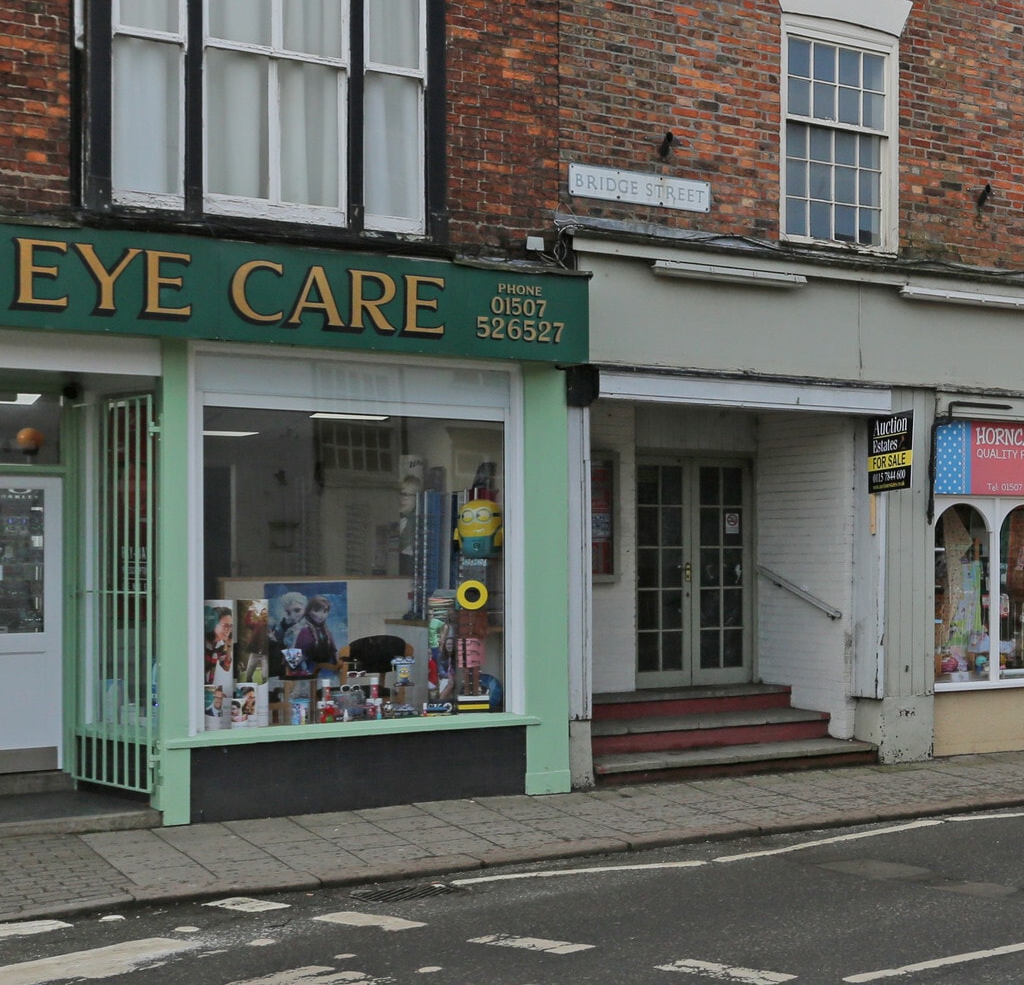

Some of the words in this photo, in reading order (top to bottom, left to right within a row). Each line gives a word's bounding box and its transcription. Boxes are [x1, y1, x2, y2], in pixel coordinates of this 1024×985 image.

[574, 173, 639, 195] BRIDGE
[646, 182, 705, 204] STREET
[12, 236, 193, 318] EYE
[229, 259, 446, 337] CARE
[497, 282, 543, 297] PHONE
[490, 296, 547, 318] 01507
[475, 316, 566, 344] 526527
[873, 416, 908, 436] Auction
[872, 438, 898, 453] Estates
[976, 448, 1018, 460] QUALITY
[872, 455, 887, 469] FOR
[888, 452, 906, 467] SALE
[1000, 482, 1023, 492] 01507
